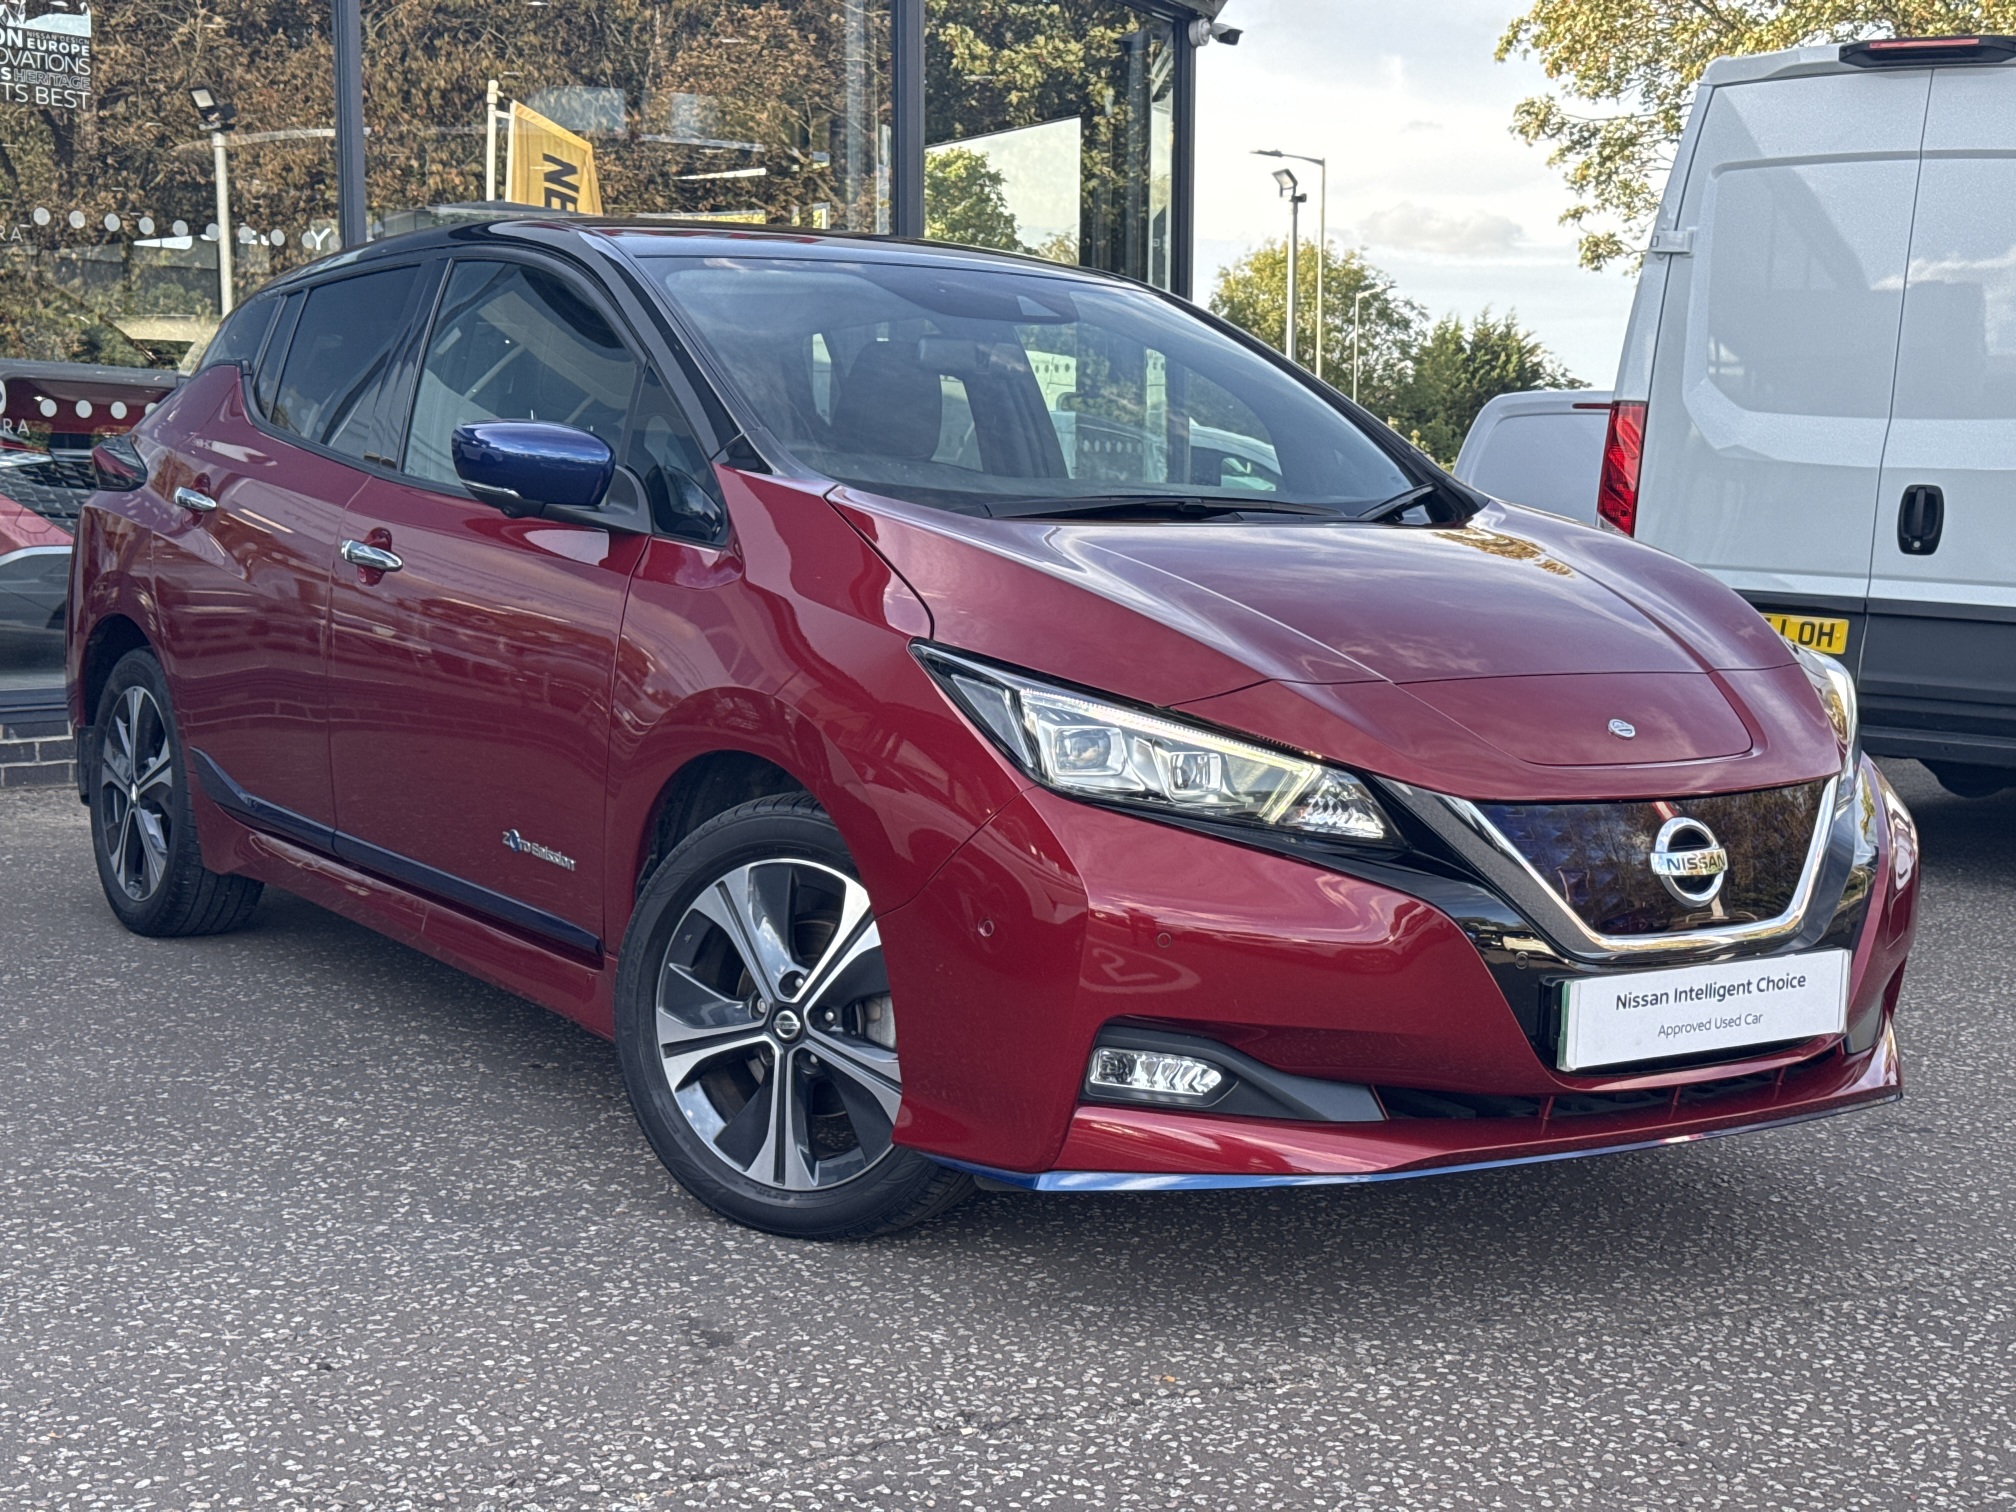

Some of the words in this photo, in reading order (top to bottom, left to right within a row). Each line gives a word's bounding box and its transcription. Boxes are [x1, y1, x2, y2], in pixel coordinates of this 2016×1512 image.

[27, 31, 57, 41] NISSAN
[59, 35, 90, 45] DESIGN
[27, 38, 90, 57] EUROPE
[13, 68, 91, 91] HERITAGE
[36, 86, 91, 110] BEST
[1665, 854, 1726, 872] NISSAN
[1615, 989, 1669, 1011] Nissan
[1674, 979, 1753, 1003] Intelligent
[1756, 973, 1807, 994] Choice
[1657, 1017, 1712, 1039] Approved
[1714, 1014, 1742, 1030] Used
[1744, 1012, 1764, 1026] Car
